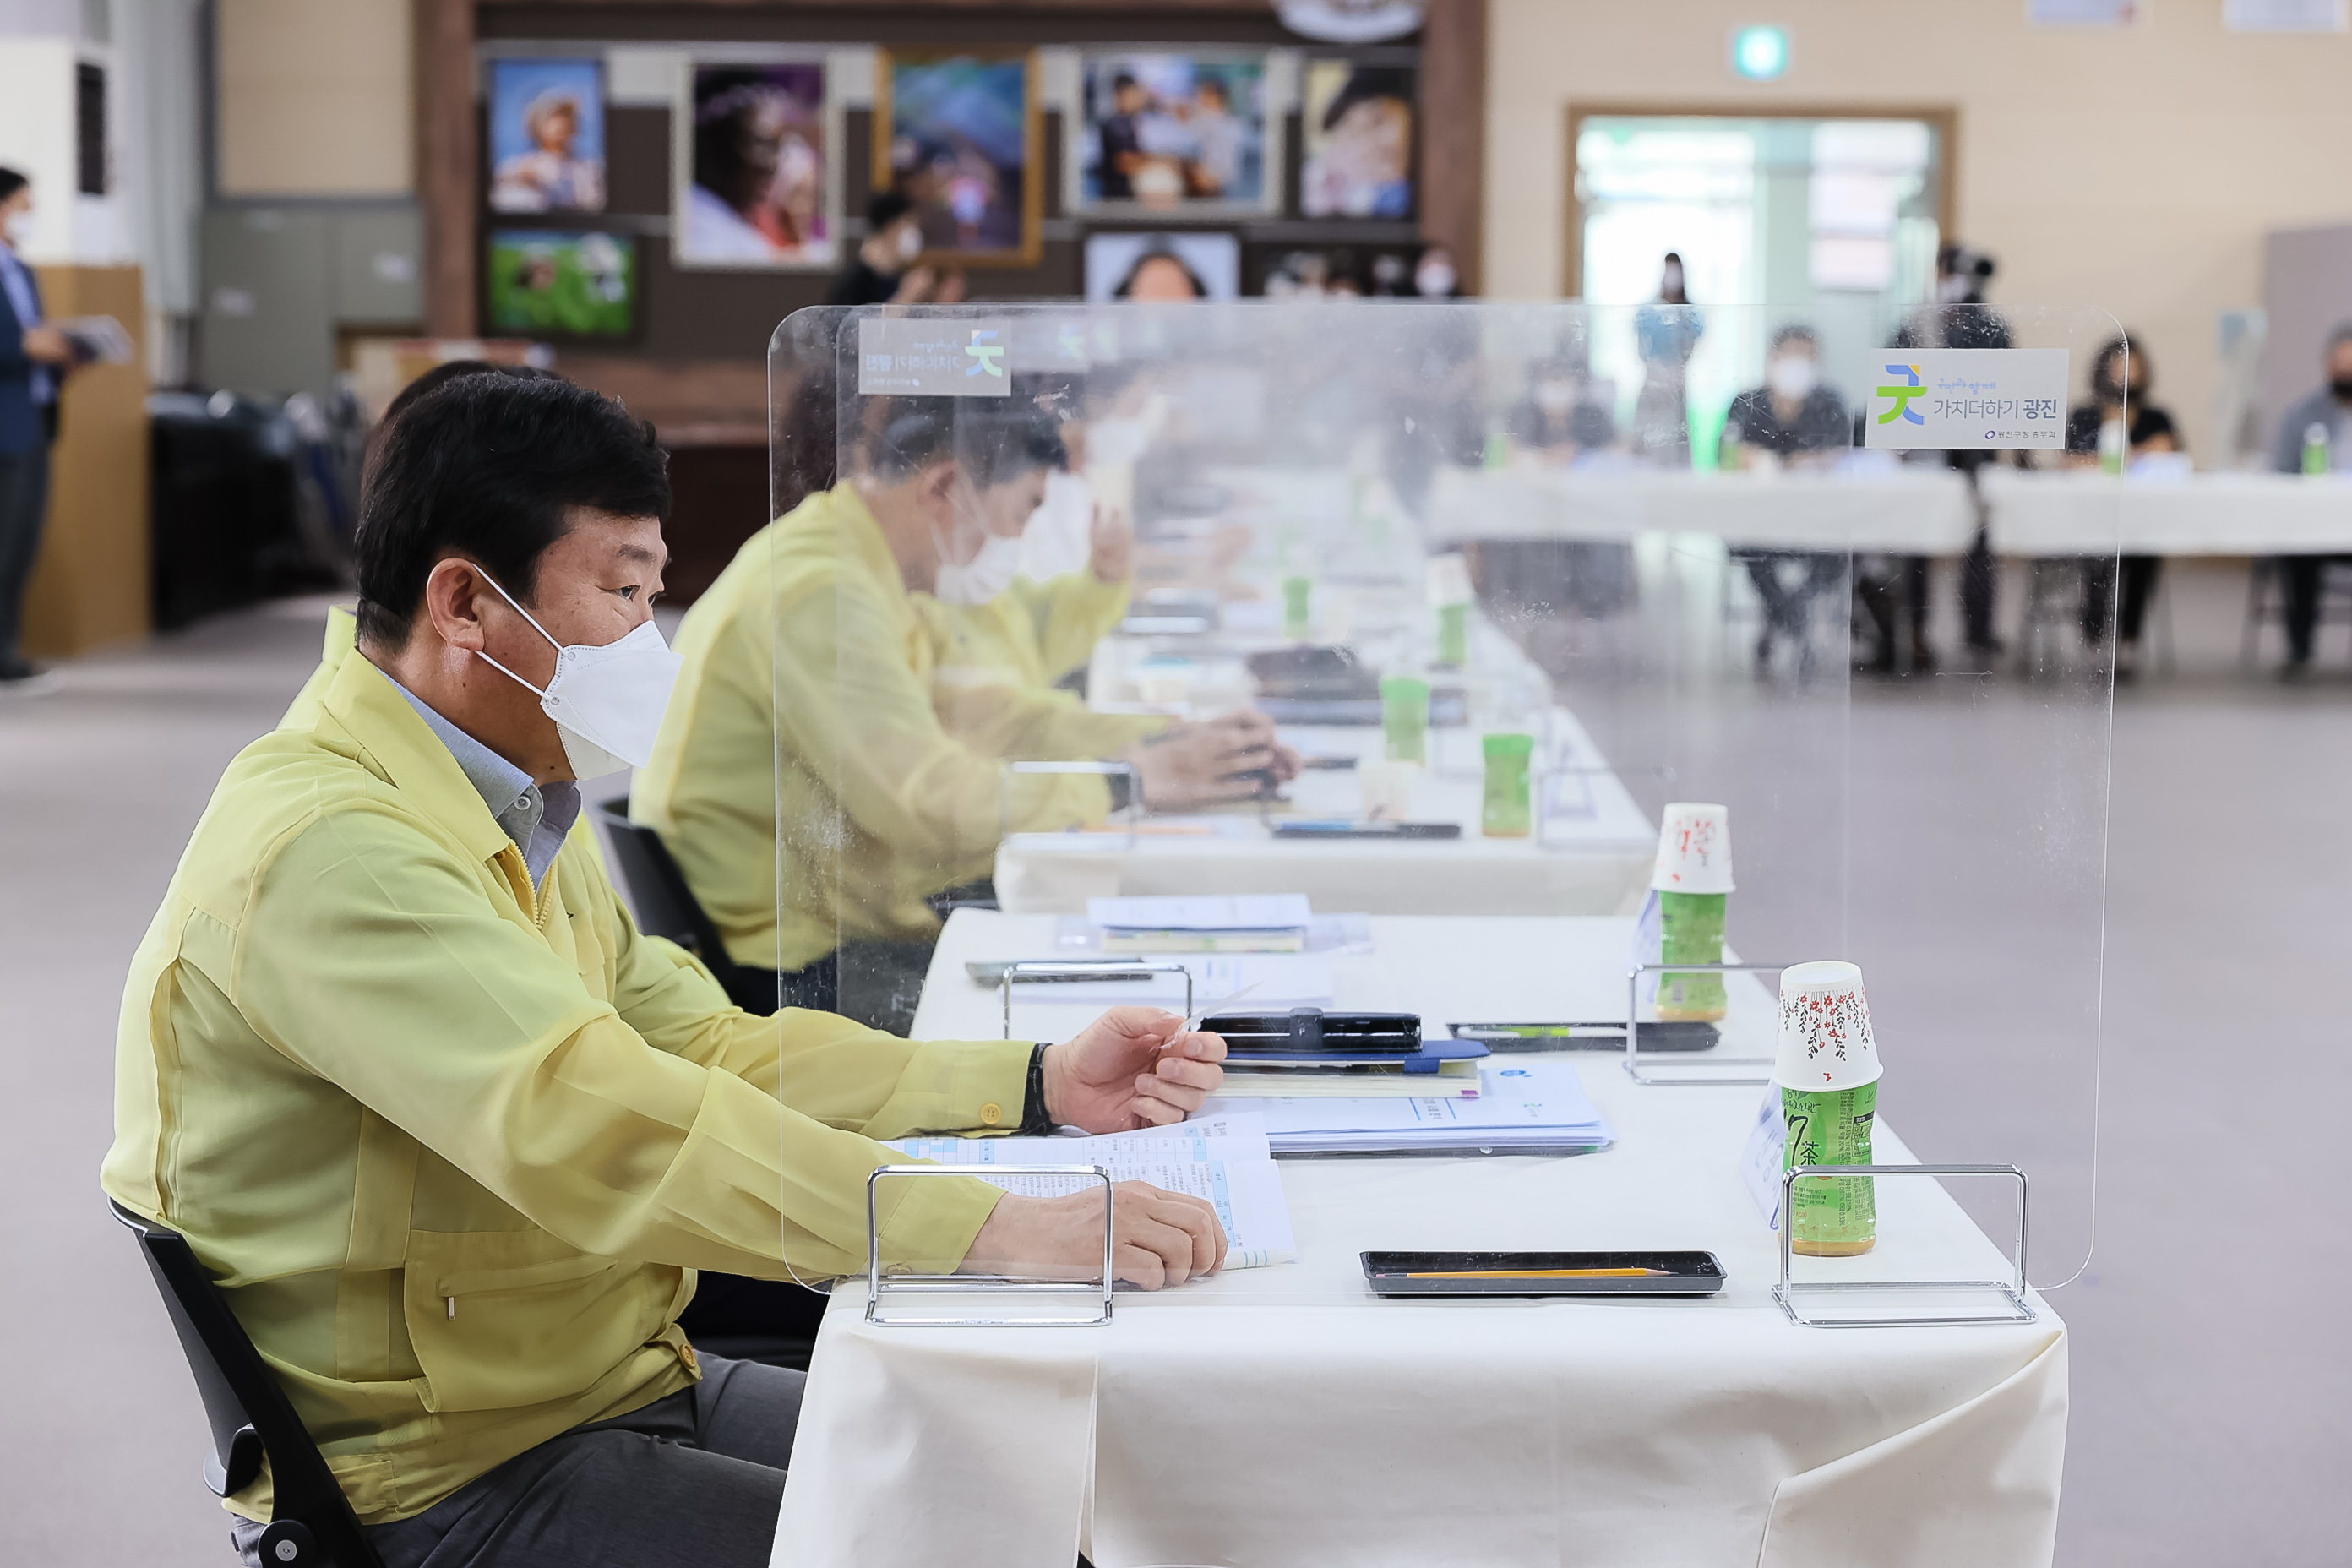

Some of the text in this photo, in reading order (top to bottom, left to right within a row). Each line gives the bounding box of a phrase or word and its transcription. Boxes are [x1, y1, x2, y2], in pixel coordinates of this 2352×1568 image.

[1934, 399, 2057, 420] 가치더하기 광진
[1997, 430, 2056, 438] 광진구청 총무과
